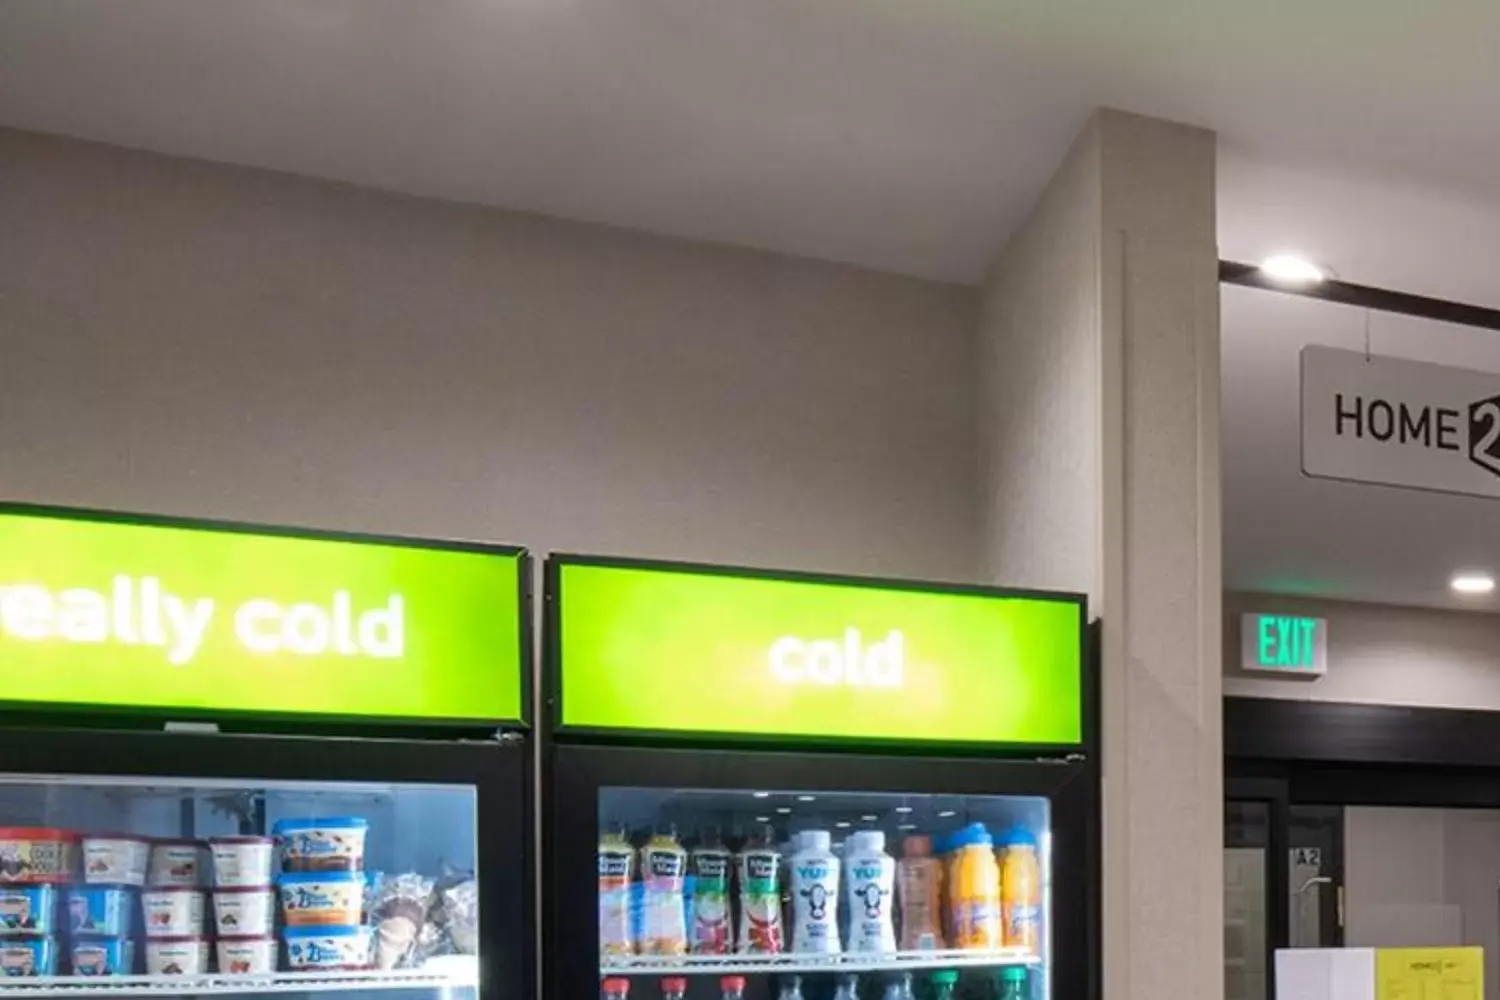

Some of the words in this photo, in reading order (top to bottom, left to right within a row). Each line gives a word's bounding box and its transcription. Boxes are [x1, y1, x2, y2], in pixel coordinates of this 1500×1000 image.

[0, 573, 214, 665] eally
[234, 590, 406, 659] cold
[1258, 614, 1316, 668] EXIT
[767, 627, 905, 687] cold
